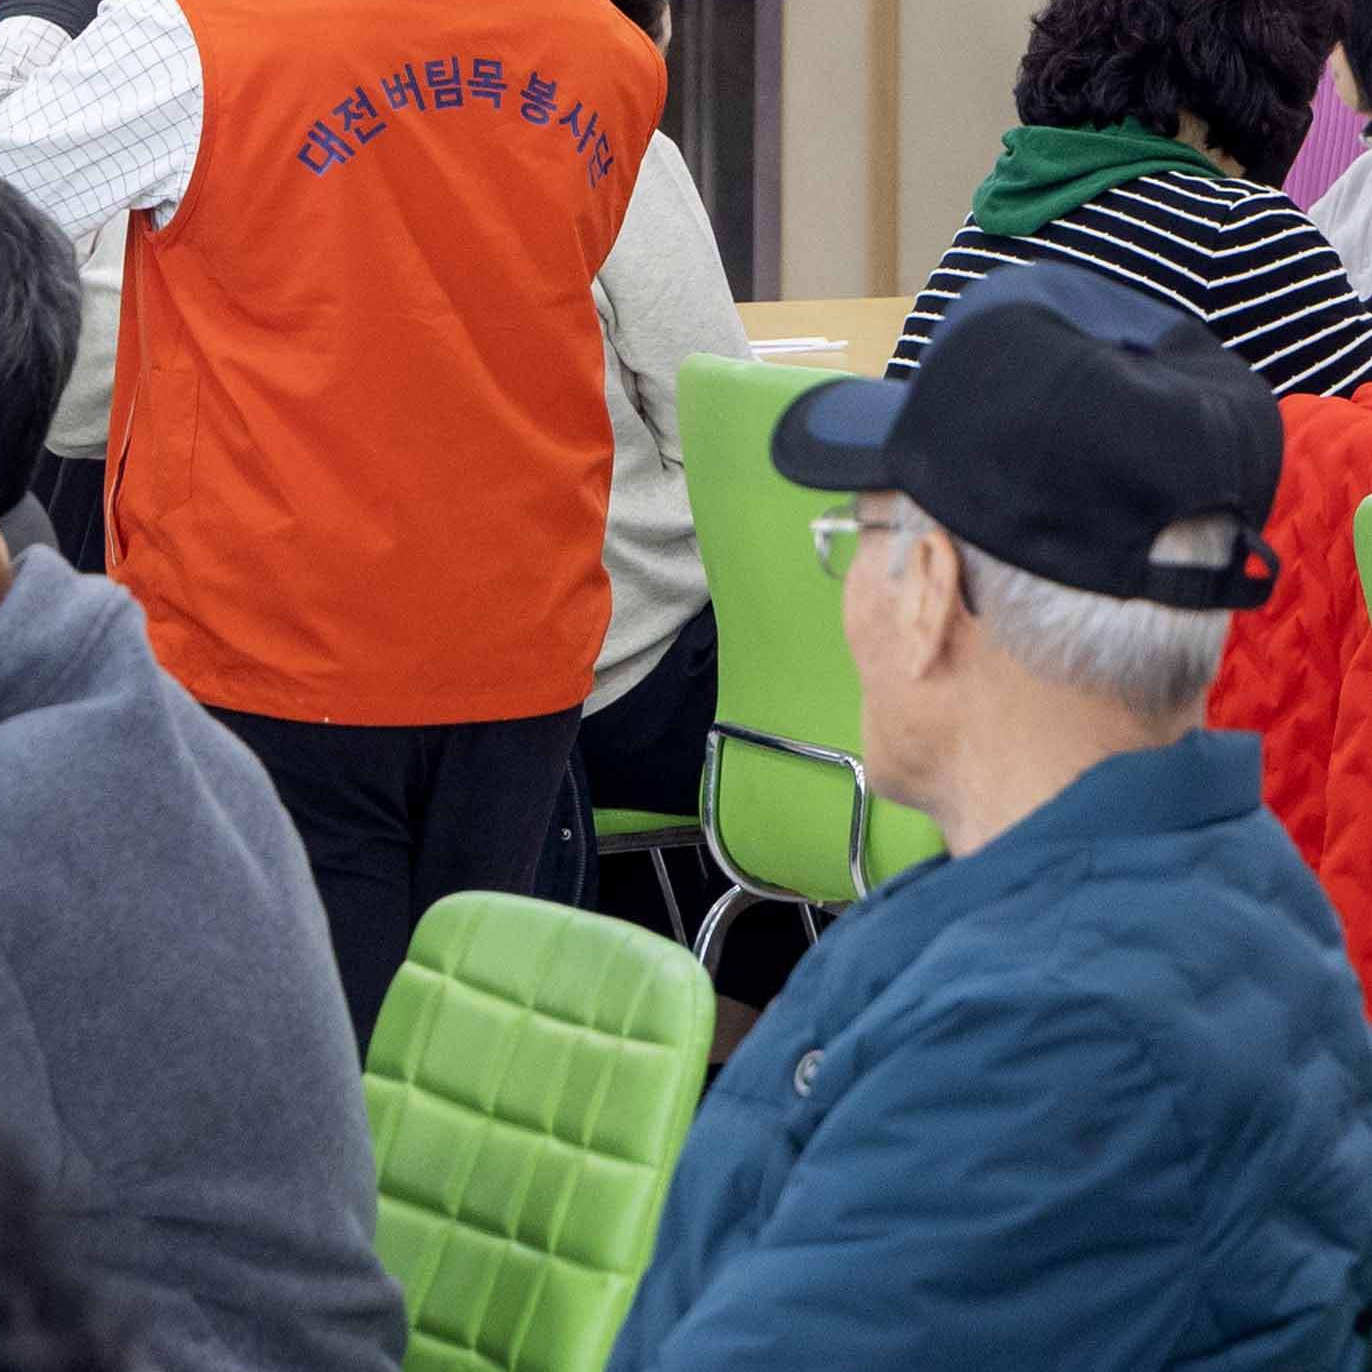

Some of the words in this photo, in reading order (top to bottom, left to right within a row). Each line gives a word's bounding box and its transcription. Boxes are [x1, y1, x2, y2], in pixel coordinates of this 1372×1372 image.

[296, 86, 388, 177] 대전
[380, 56, 509, 113] 버팀목
[519, 71, 615, 188] 봉사단
